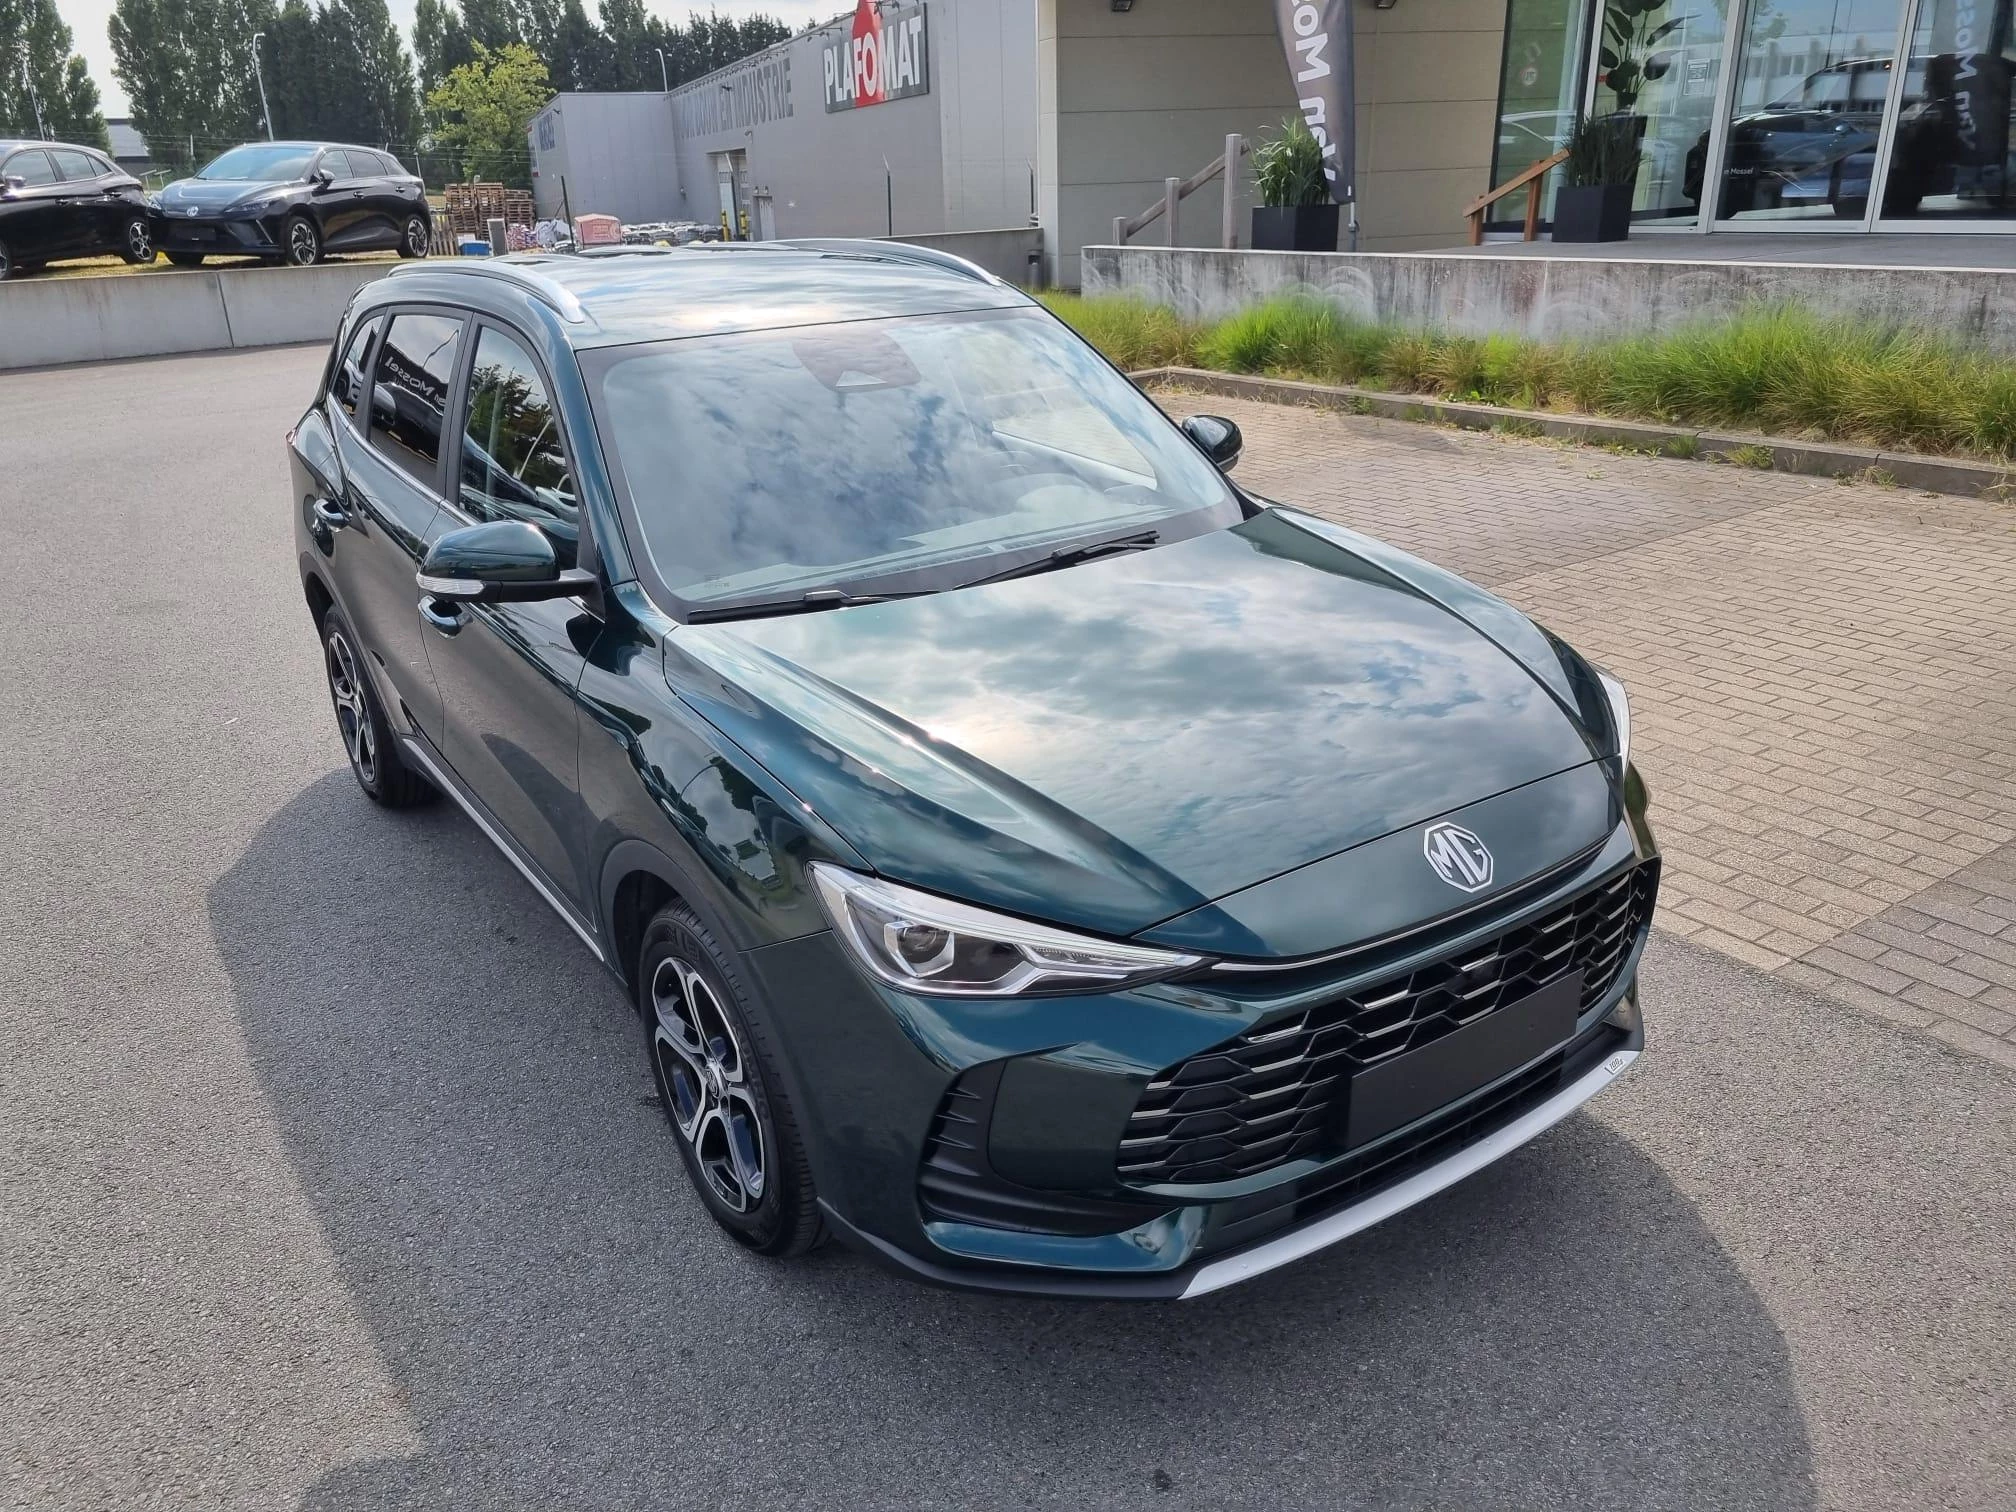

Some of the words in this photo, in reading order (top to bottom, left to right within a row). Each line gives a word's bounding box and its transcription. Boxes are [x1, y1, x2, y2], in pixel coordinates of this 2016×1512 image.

[734, 58, 794, 129] INDUSTRIE
[824, 16, 921, 104] PLAFOMAT
[1430, 829, 1489, 885] MG
